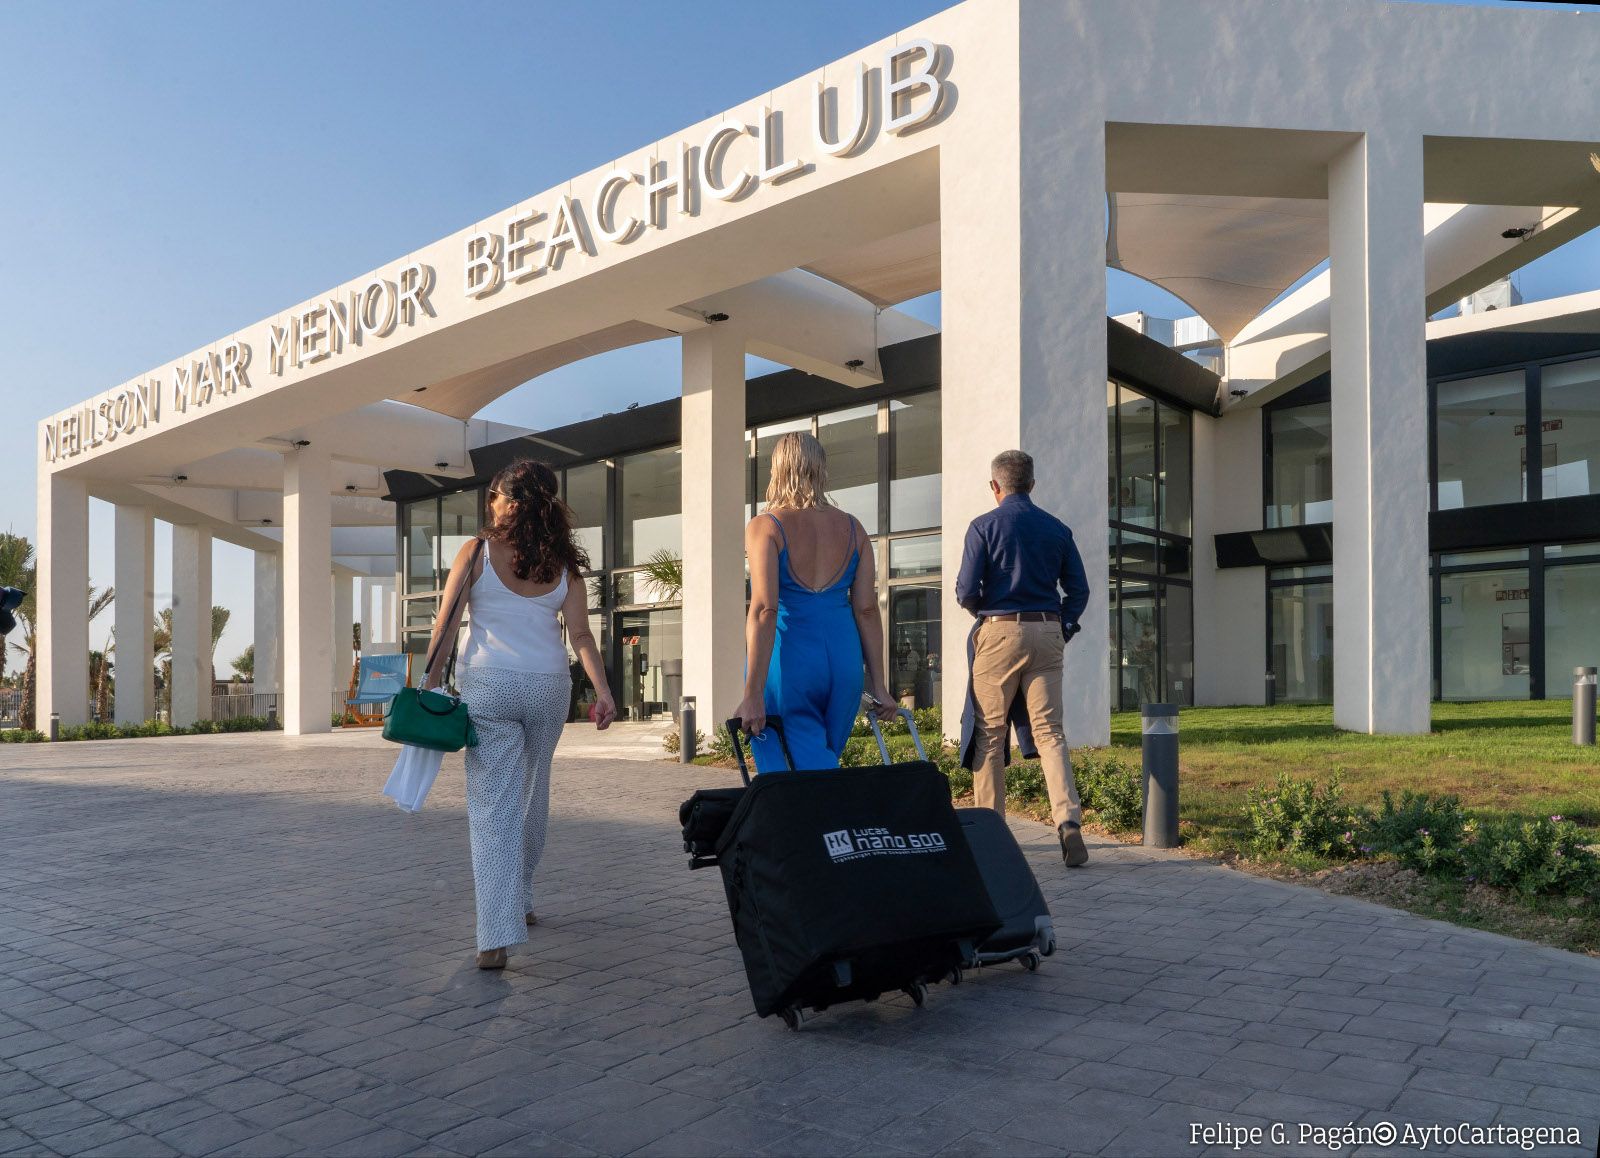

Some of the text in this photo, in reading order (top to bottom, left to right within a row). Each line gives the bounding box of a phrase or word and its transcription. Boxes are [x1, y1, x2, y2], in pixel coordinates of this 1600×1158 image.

[45, 376, 160, 463] NEILSON
[172, 339, 252, 414] MAR
[266, 261, 437, 376] MENOR
[826, 832, 849, 849] HK
[856, 833, 945, 850] nano 600
